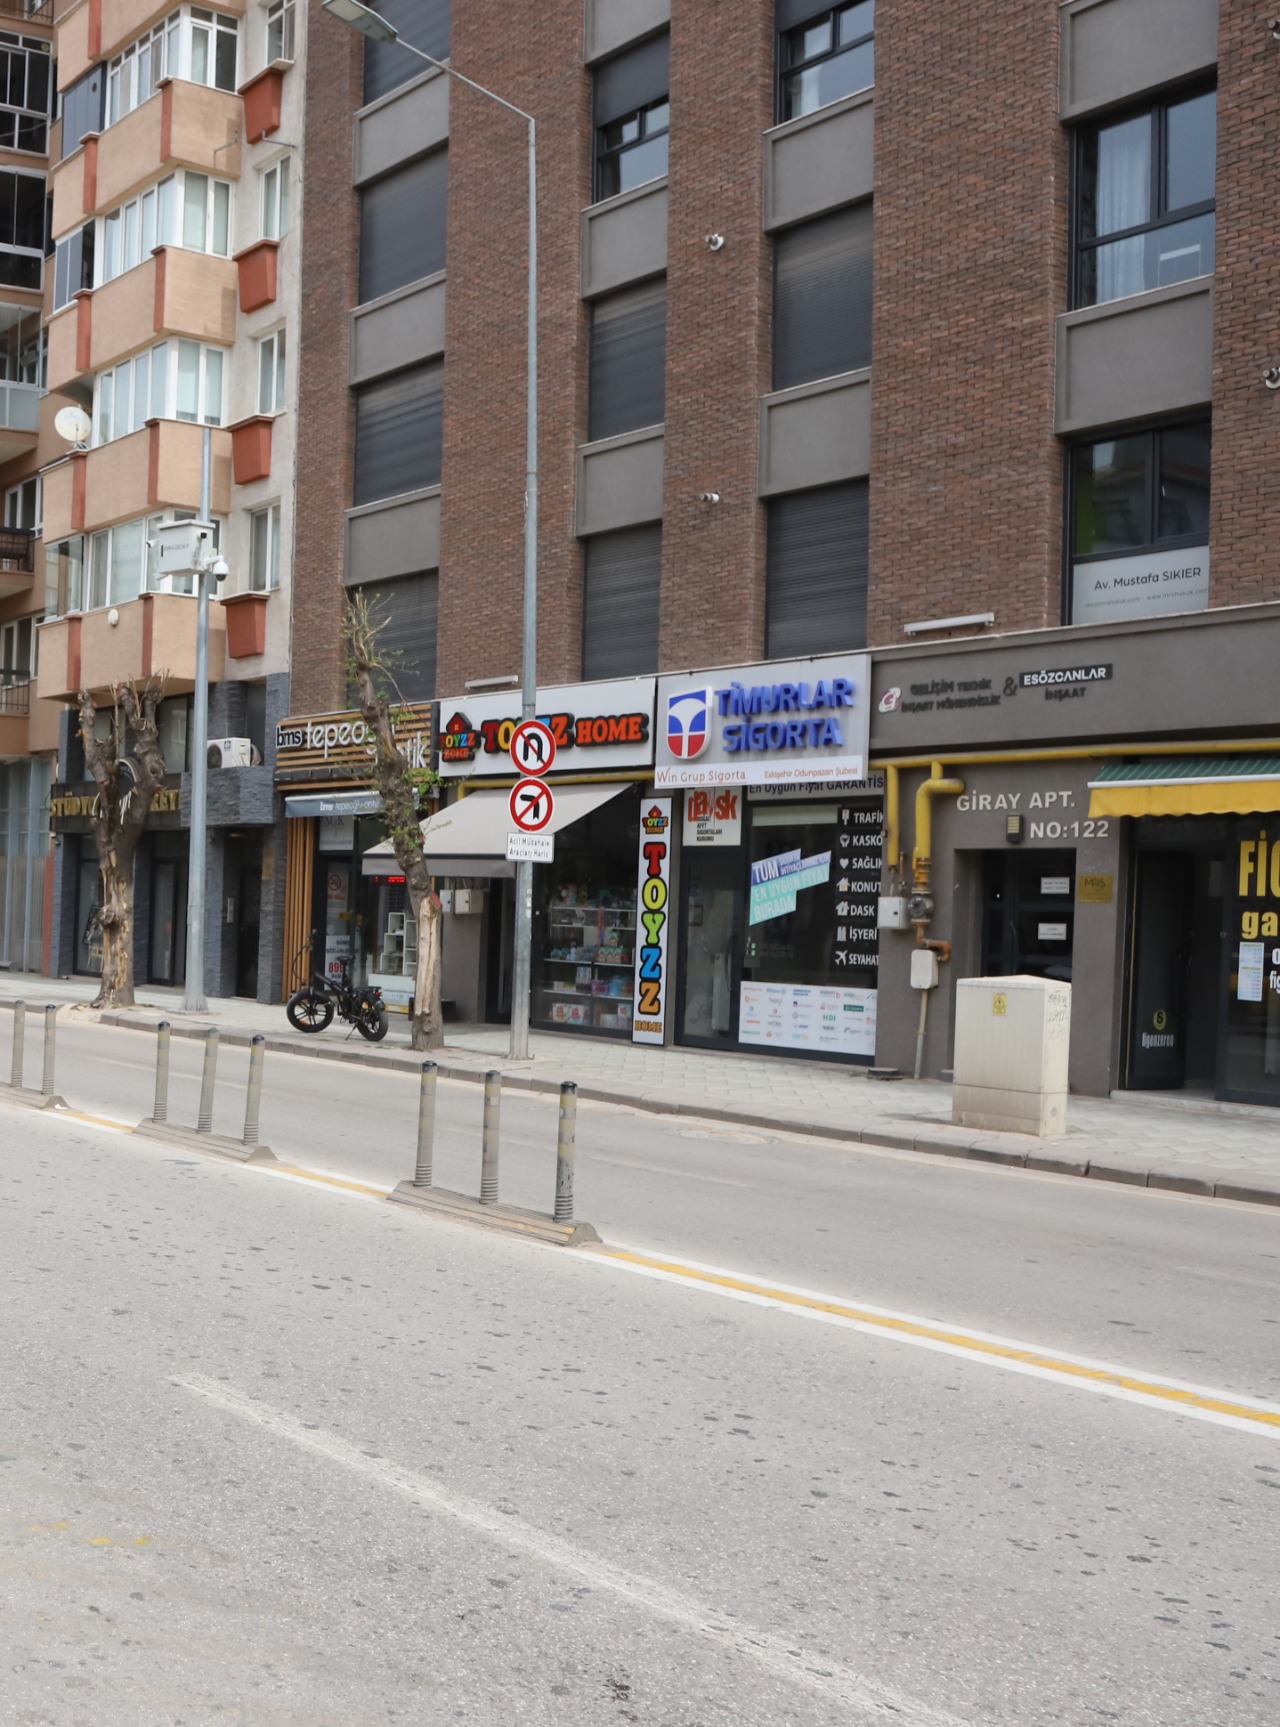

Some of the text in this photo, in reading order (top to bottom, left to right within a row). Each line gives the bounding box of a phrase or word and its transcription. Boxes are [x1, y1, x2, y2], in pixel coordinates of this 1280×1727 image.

[1094, 566, 1202, 591] Av. Mustafa SIKIER
[1023, 667, 1107, 686] ESÖZCANLAR
[714, 678, 854, 717] TİMURLAR
[1045, 686, 1086, 702] İNŞAAT
[276, 725, 302, 749] bms
[439, 731, 477, 749] TOYZZ
[482, 713, 645, 753] TOZ HOME
[722, 716, 844, 753] SİGORTA
[657, 767, 746, 784] Win Grup Sigorta
[749, 784, 764, 794] En
[765, 781, 796, 795] Uygun
[956, 790, 1075, 811] GİRAY APT.
[642, 816, 669, 828] TOYZZ
[1030, 820, 1109, 839] NO:122
[852, 835, 882, 846] KASKO
[851, 881, 882, 893] KONUT
[850, 905, 875, 916] DASK
[638, 841, 667, 1015] TOYZZ
[849, 927, 878, 942] İŞYERİ
[848, 953, 879, 966] SEYAHAT
[634, 1020, 663, 1034] HOME
